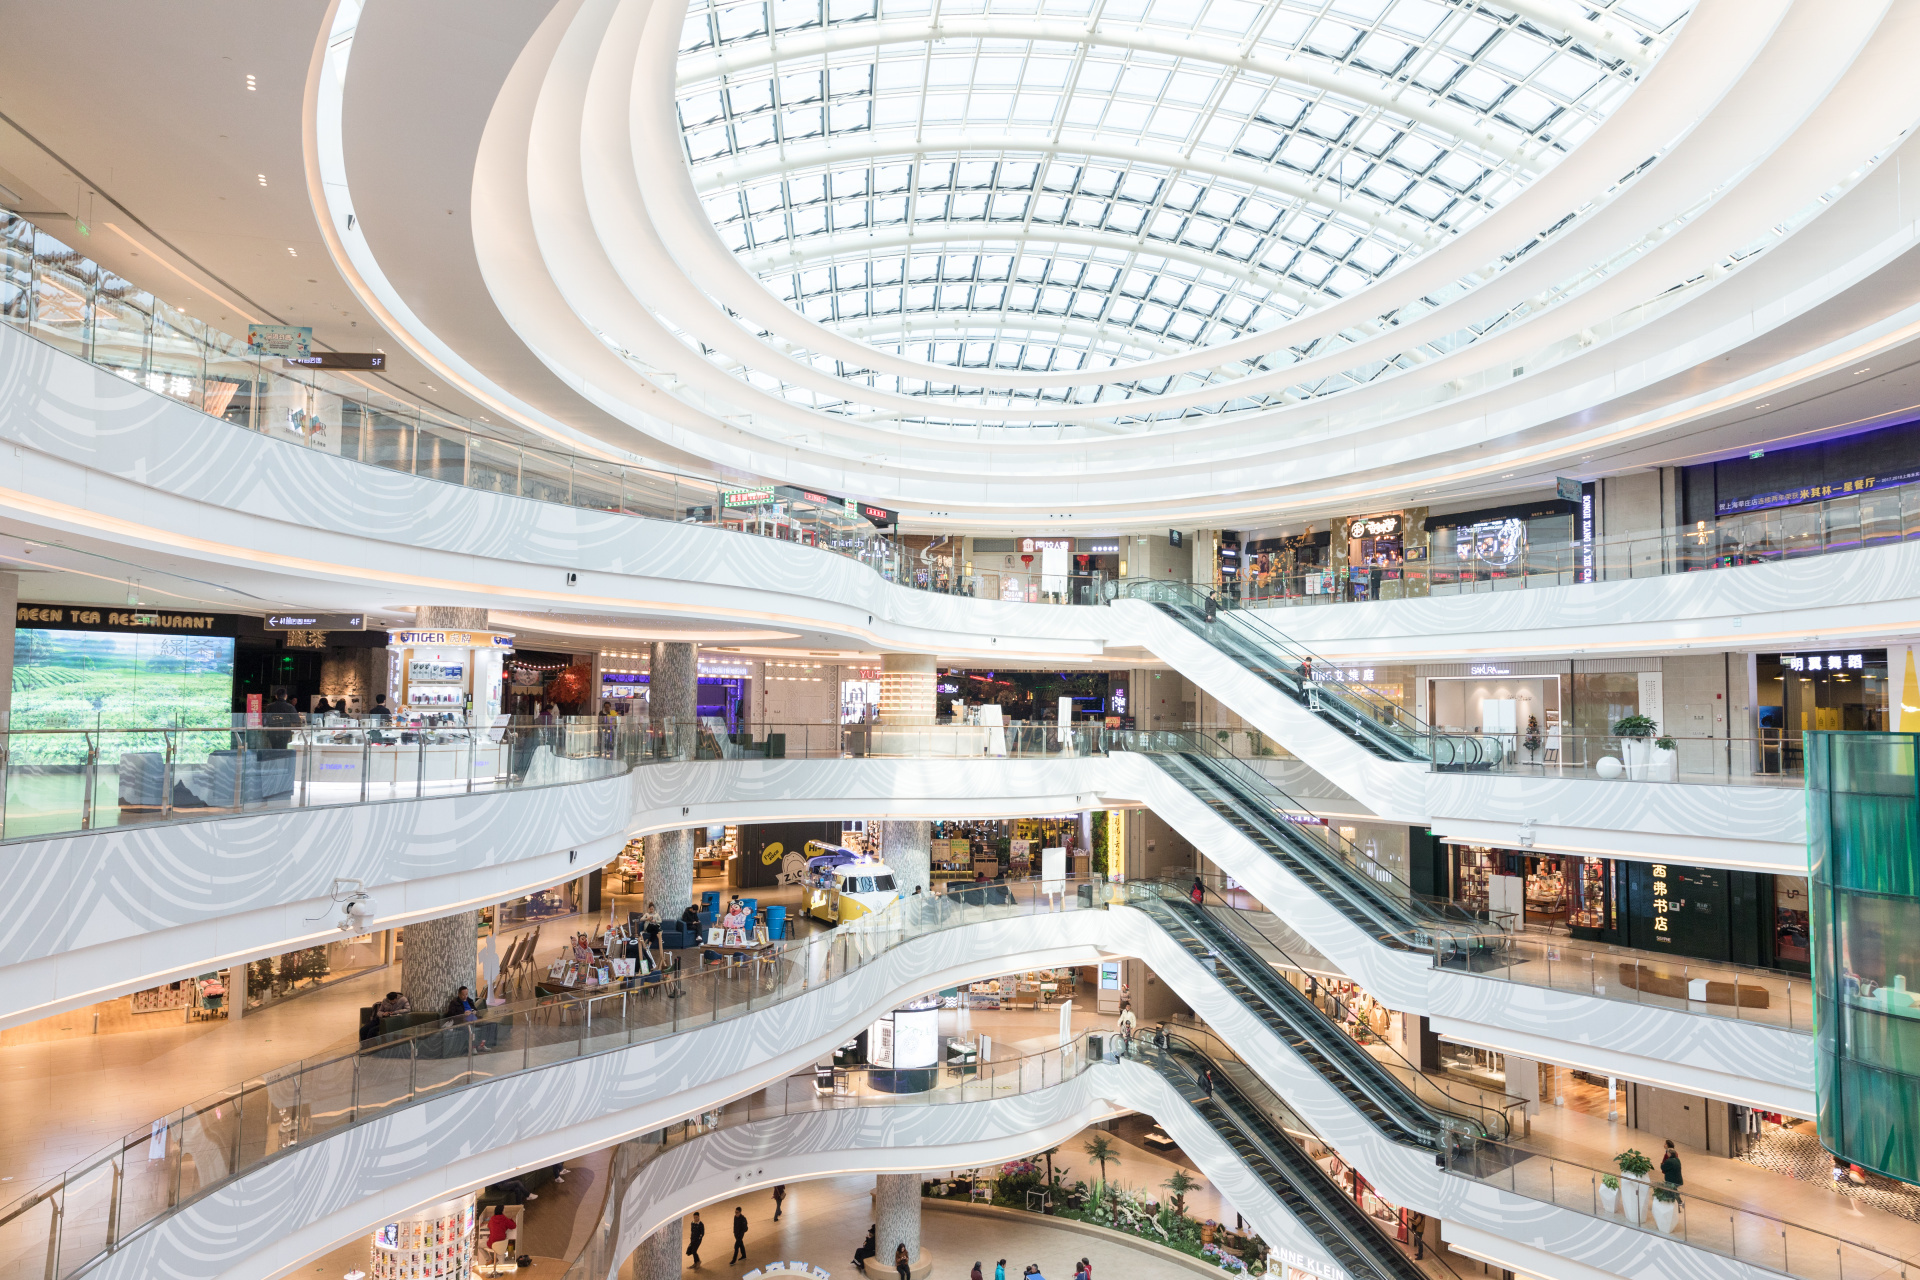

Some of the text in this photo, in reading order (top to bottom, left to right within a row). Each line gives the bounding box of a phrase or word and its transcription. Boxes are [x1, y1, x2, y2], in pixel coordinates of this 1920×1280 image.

[371, 358, 382, 366] 5F
[1799, 477, 1876, 500] 米其林一星餐厅
[70, 610, 101, 624] TEA
[350, 618, 360, 626] 4F
[409, 632, 472, 644] TIGER 虎牌
[1471, 663, 1497, 675] SAKURA
[1652, 864, 1668, 932] 西弗书店
[1271, 1244, 1344, 1280] ANNE KLEIN
